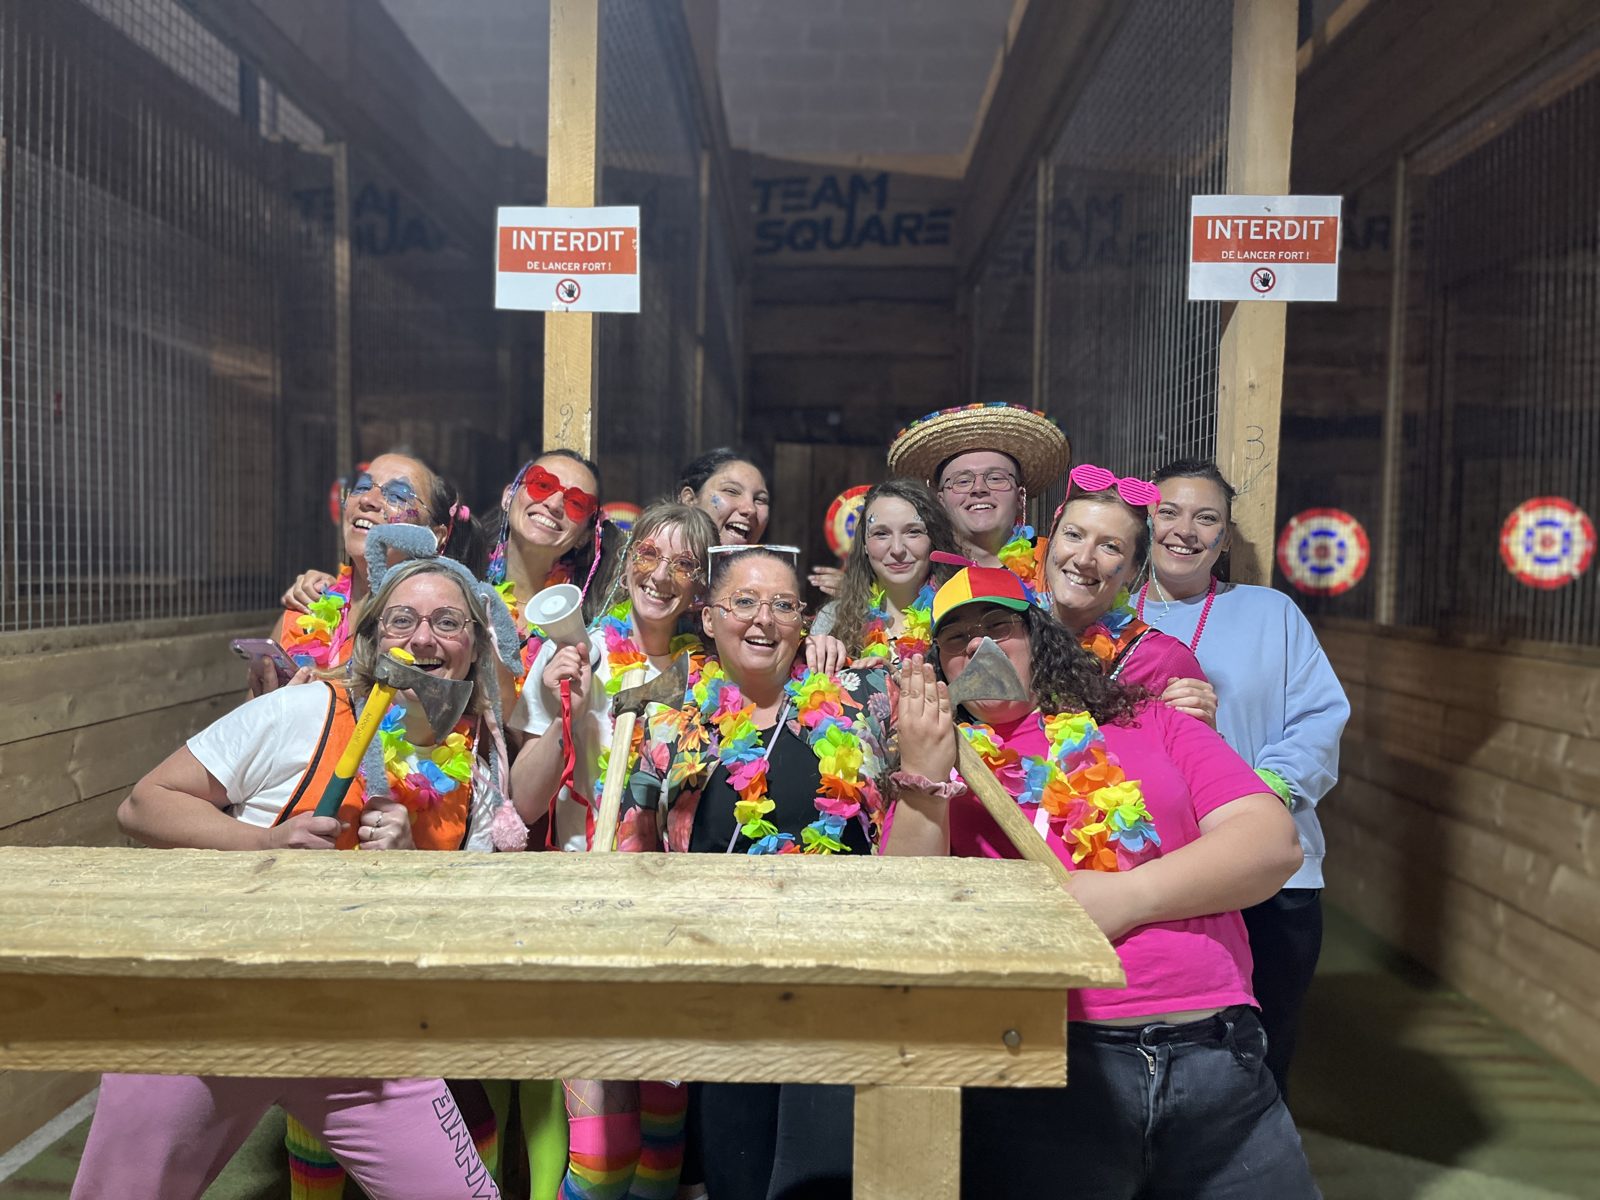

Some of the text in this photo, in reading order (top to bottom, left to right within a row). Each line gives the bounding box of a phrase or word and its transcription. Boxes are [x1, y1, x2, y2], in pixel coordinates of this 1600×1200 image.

[752, 172, 888, 213] TEAM
[753, 207, 956, 256] SQUARE
[1207, 219, 1325, 240] INTERDIT
[512, 230, 625, 252] INTERDIT
[527, 261, 540, 270] DE
[542, 262, 580, 271] LANCER
[1221, 250, 1235, 260] DE
[1237, 250, 1276, 260] LANCER
[1246, 425, 1265, 460] 3
